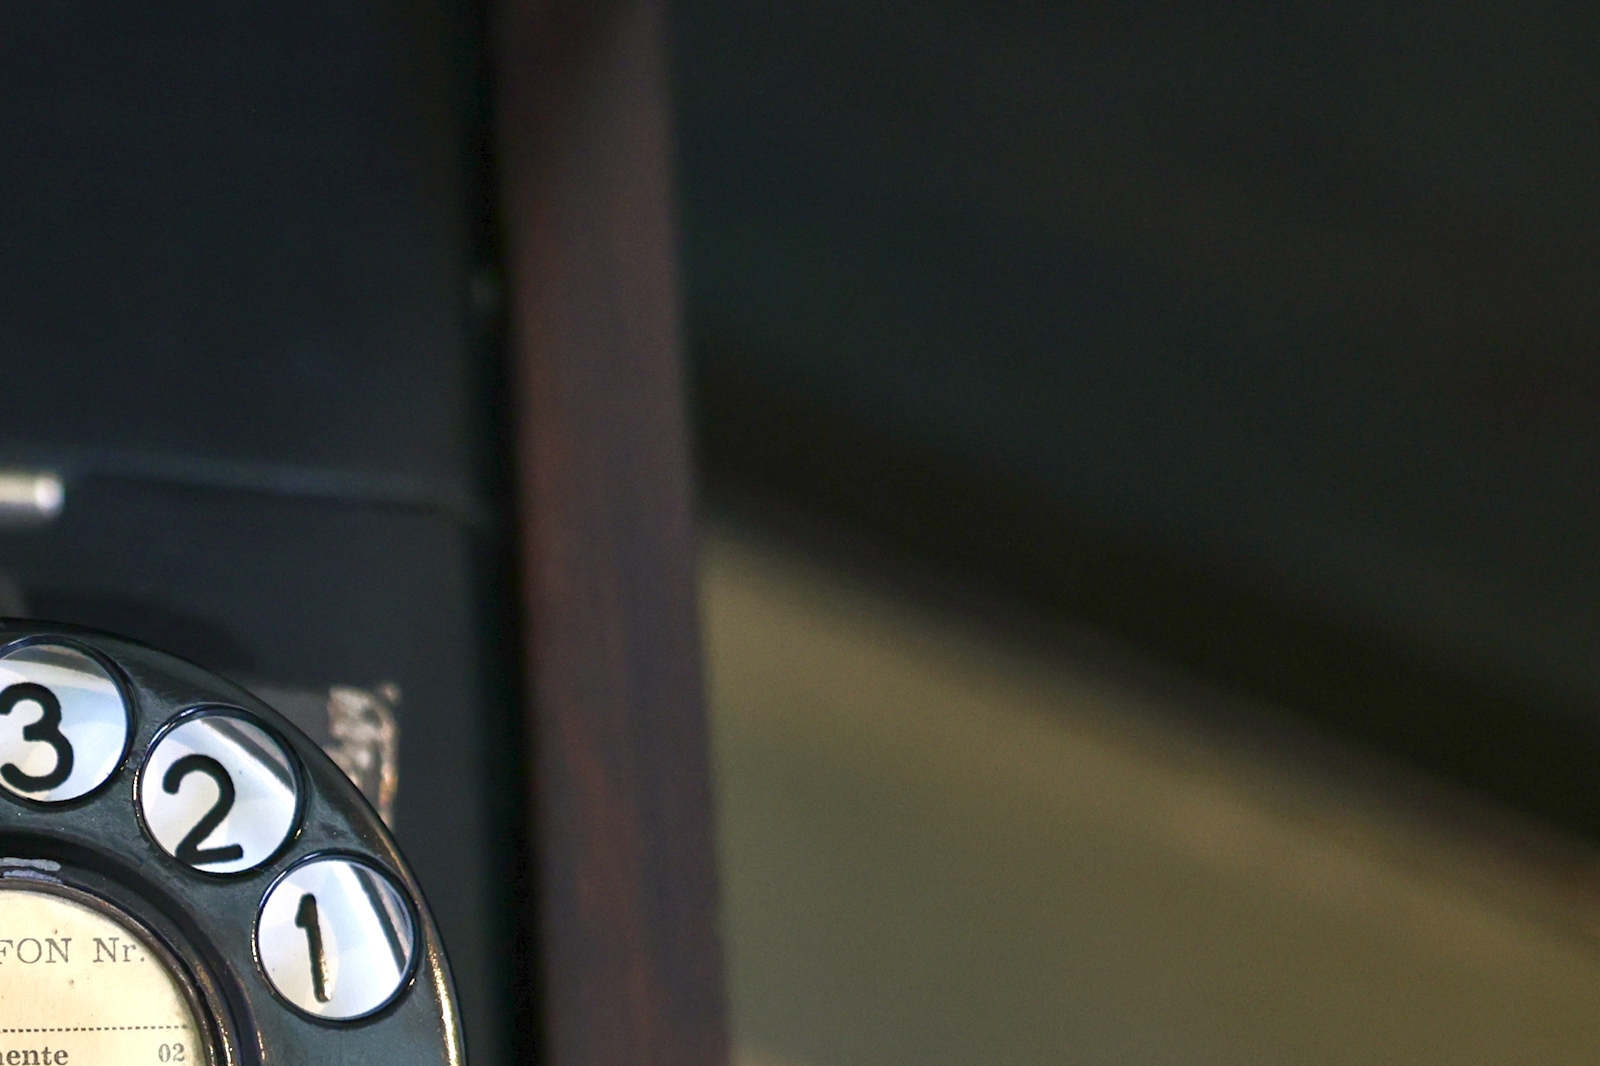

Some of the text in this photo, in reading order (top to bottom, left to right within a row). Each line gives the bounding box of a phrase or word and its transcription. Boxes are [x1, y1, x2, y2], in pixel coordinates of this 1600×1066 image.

[161, 753, 244, 865] 2
[92, 936, 146, 964] Nr.
[294, 892, 333, 1003] 1
[158, 1043, 186, 1063] 02
